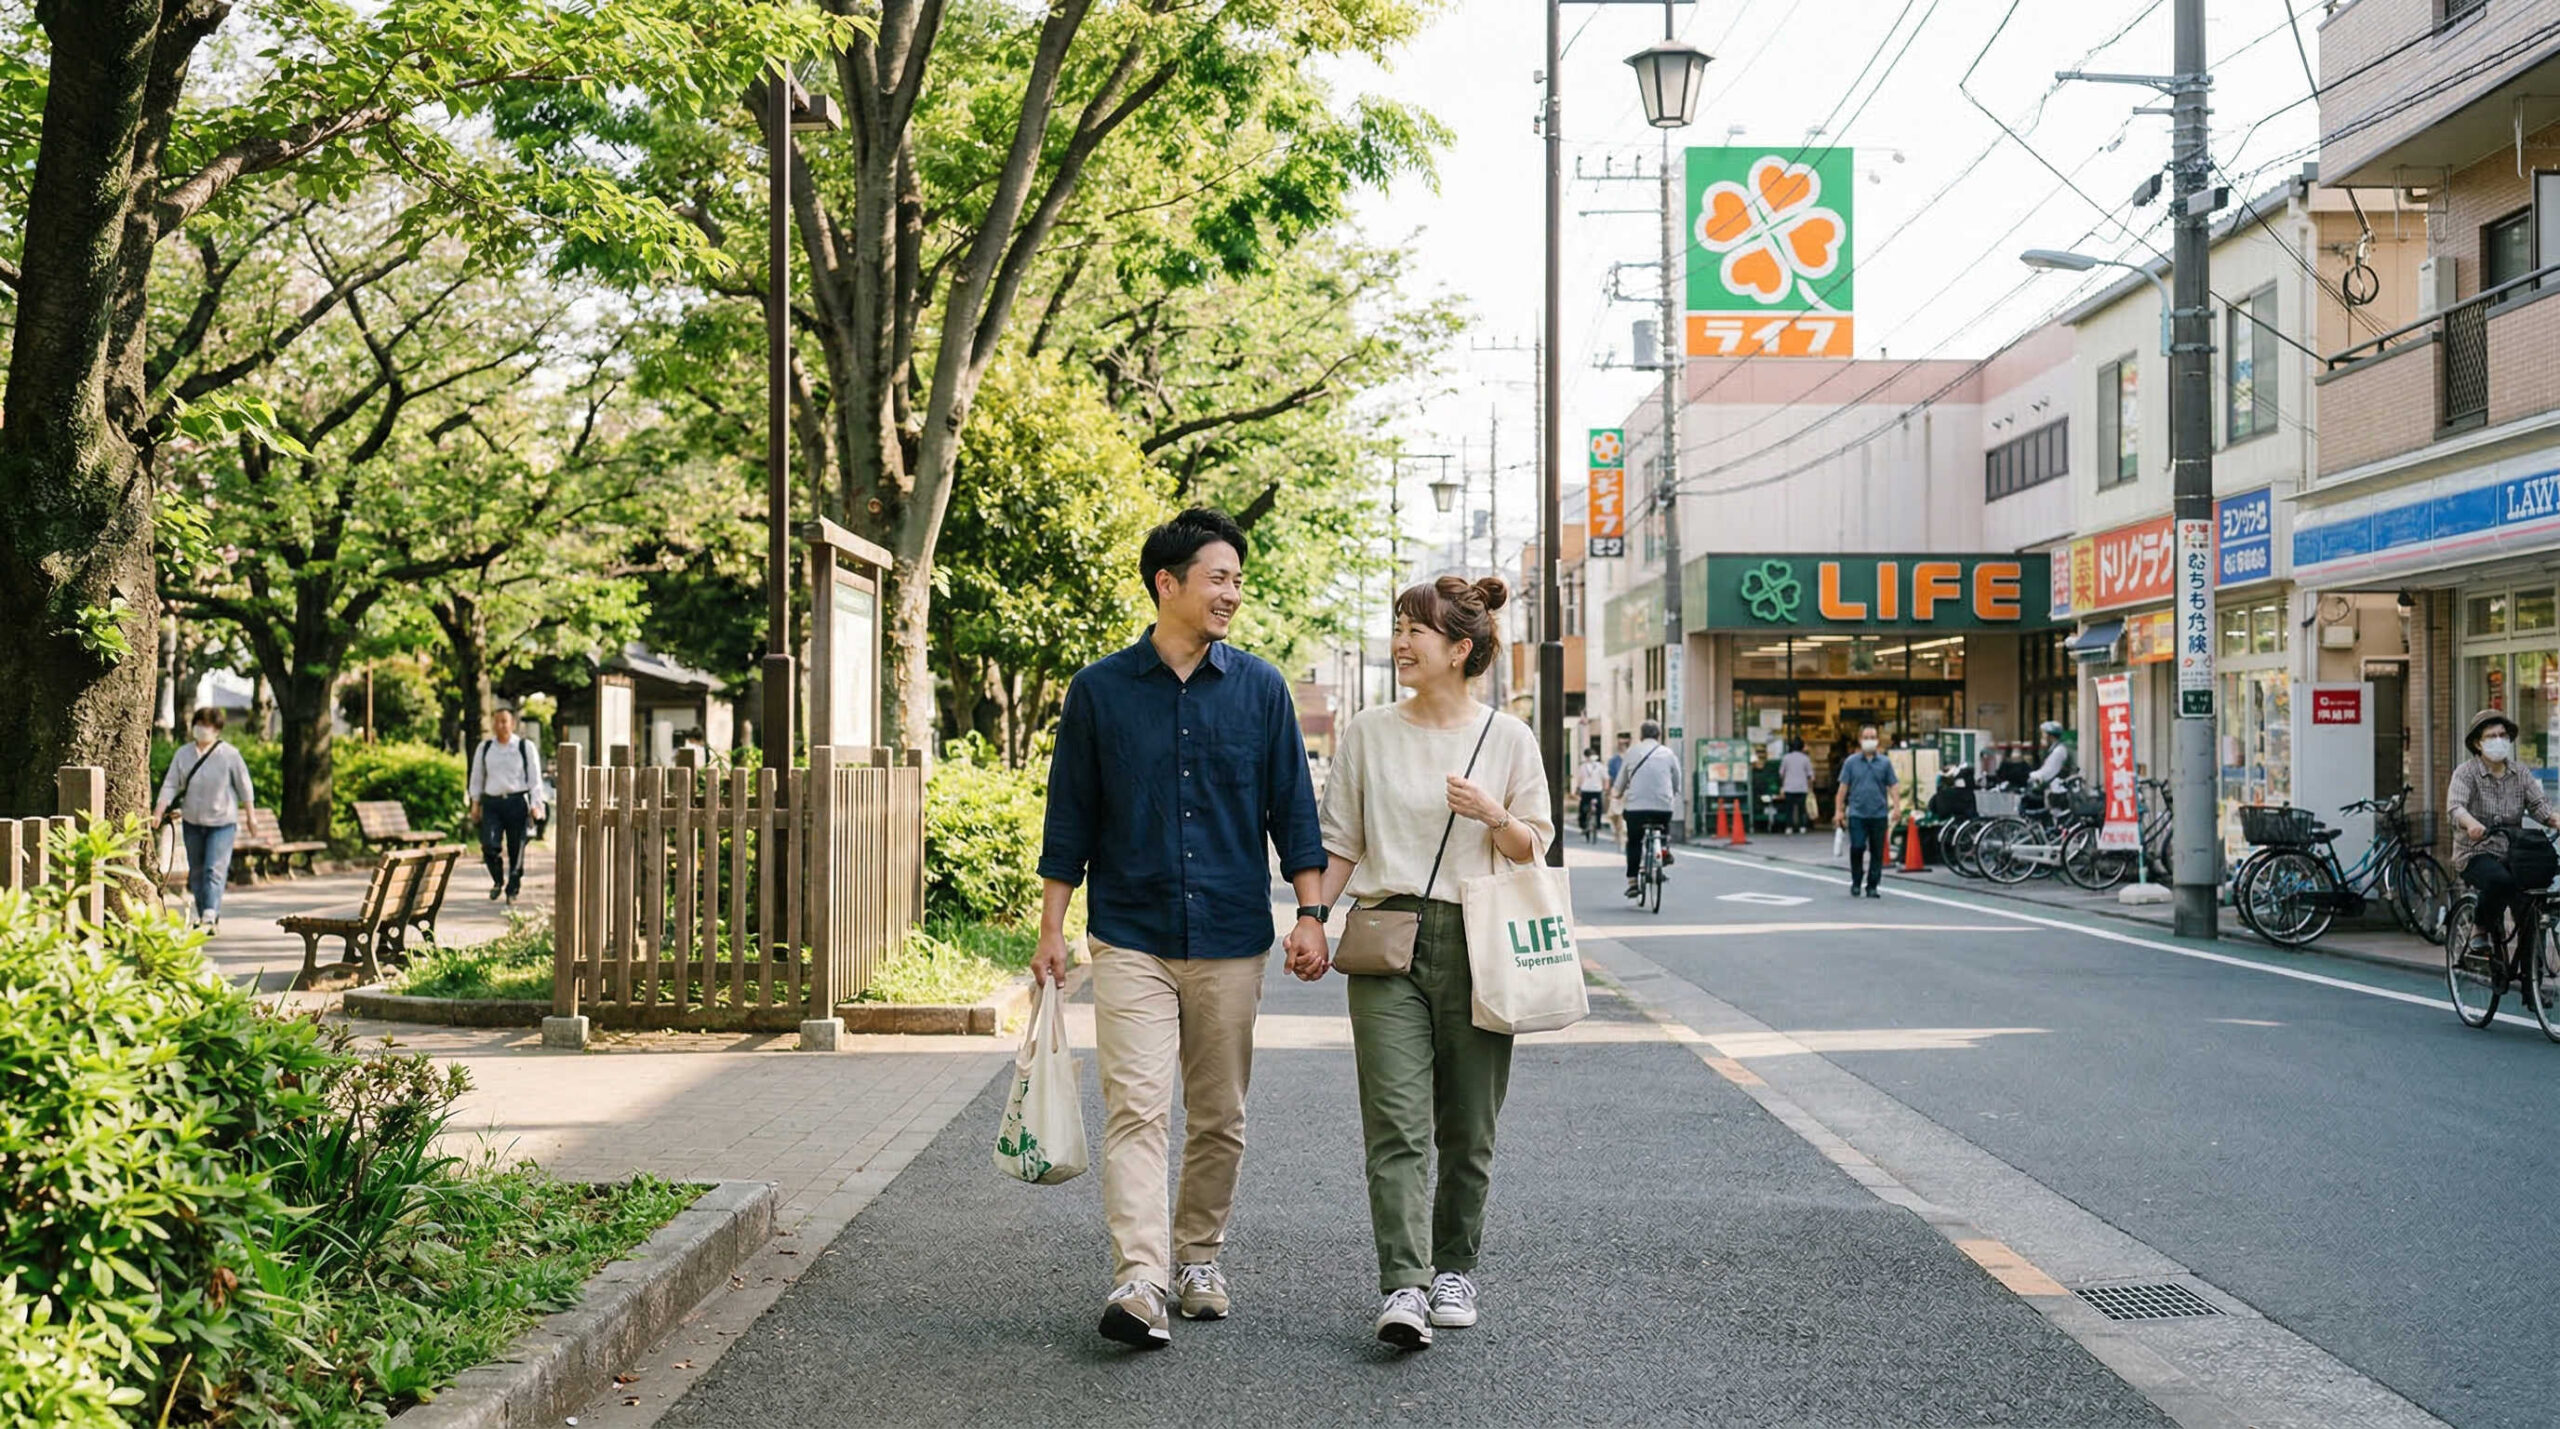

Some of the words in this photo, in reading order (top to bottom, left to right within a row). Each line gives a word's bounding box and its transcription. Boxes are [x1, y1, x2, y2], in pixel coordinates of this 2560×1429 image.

[1704, 320, 1837, 353] ライフ
[2507, 475, 2560, 520] LAW
[1818, 561, 2021, 620] LIFE
[1508, 915, 1570, 955] LIFE
